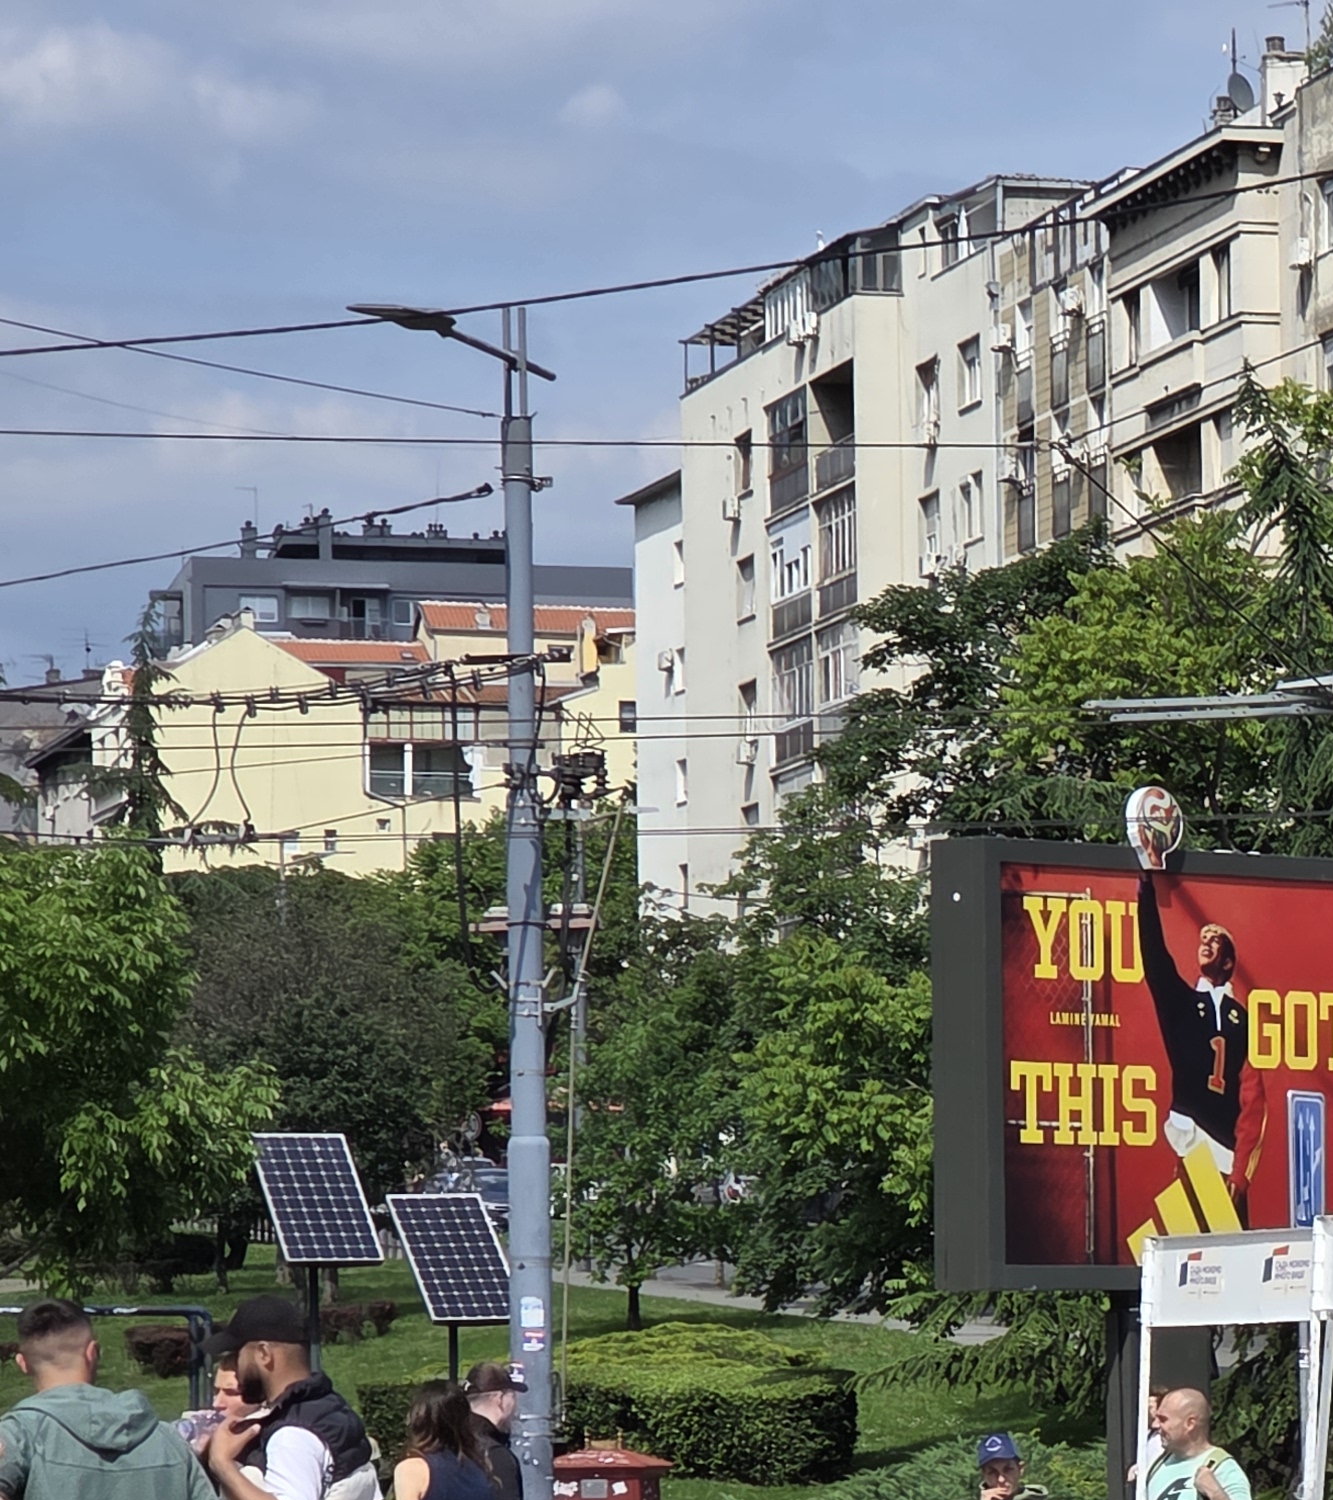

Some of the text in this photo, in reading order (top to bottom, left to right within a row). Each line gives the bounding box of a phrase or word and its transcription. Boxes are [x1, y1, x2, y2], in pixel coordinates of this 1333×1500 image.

[1023, 896, 1145, 983] YOU
[1050, 1011, 1087, 1026] LAMINE
[1010, 1060, 1157, 1147] THIS
